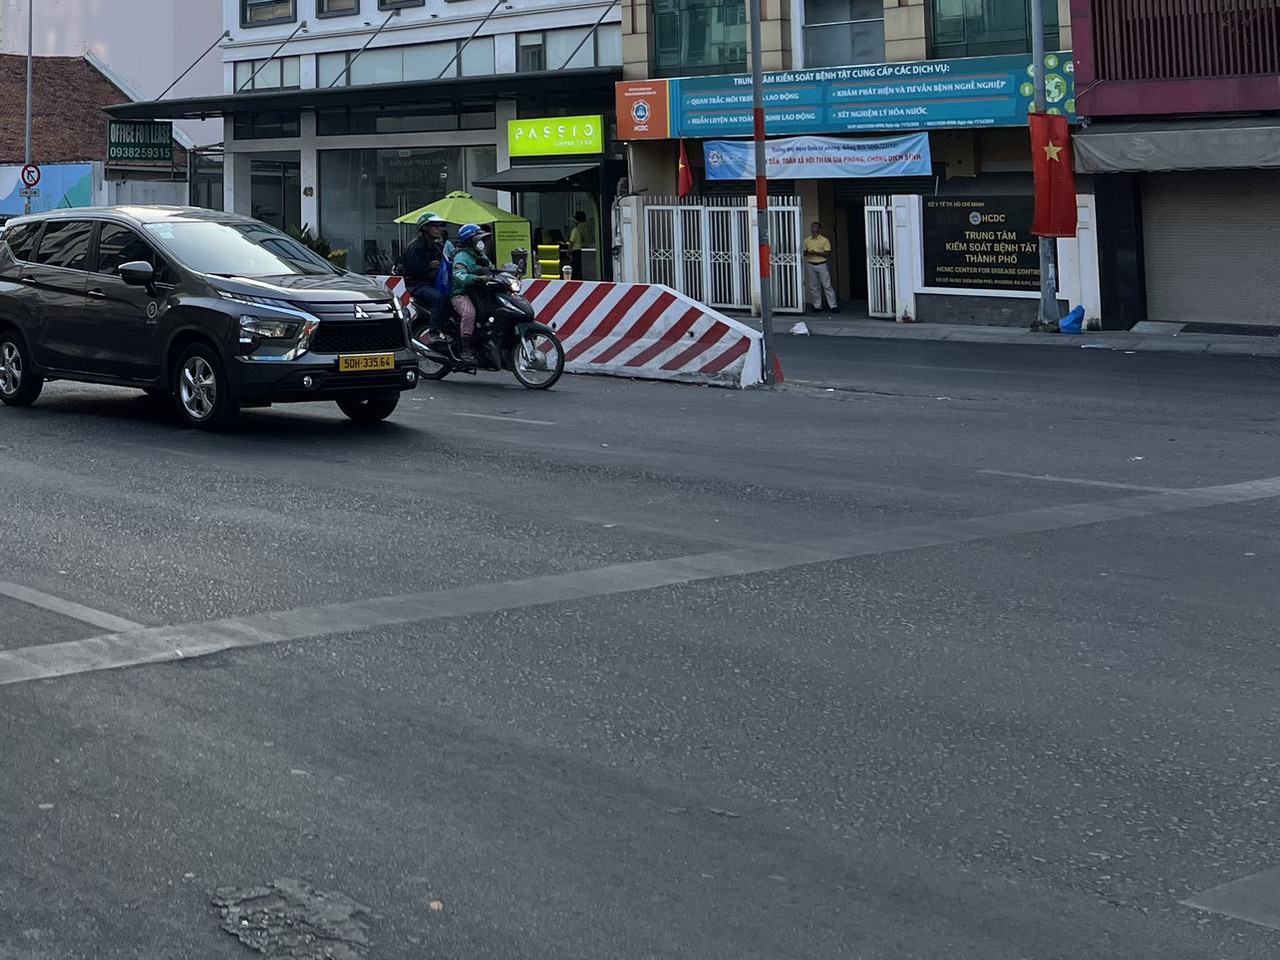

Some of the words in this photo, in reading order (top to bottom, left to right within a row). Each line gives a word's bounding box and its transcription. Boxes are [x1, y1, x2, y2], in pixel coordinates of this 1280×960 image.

[734, 77, 753, 86] TRUN
[762, 74, 775, 84] ÂM
[776, 72, 794, 83] KIỂM
[795, 71, 814, 82] SOÁT
[816, 70, 836, 82] BỆNH
[837, 69, 851, 80] TẬT
[852, 68, 875, 78] CUNG
[877, 66, 893, 76] CẤP
[894, 65, 911, 75] CÁC
[912, 64, 934, 75] DỊCH
[934, 63, 950, 74] VỤ:
[895, 85, 905, 93] VÀ
[933, 83, 953, 93] BỆNH
[976, 79, 1006, 89] NGHIỆP
[781, 113, 795, 121] LAO
[110, 123, 134, 143] OFFICE
[135, 124, 149, 143] FOR
[150, 125, 170, 144] LEASE
[515, 124, 593, 140] PASSIO
[110, 147, 170, 158] 0938259315
[982, 214, 1006, 222] HCDC
[965, 231, 995, 240] TRUNG
[996, 229, 1016, 240] TÂM
[946, 240, 967, 251] KIỂM
[969, 241, 992, 252] SOÁT
[993, 242, 1018, 253] BỆNH
[1019, 242, 1037, 254] TẬT
[965, 253, 996, 264] THÀNH
[998, 253, 1018, 264] PHỐ
[991, 267, 1016, 275] DISEASE
[344, 356, 390, 369] 50H-335.64
